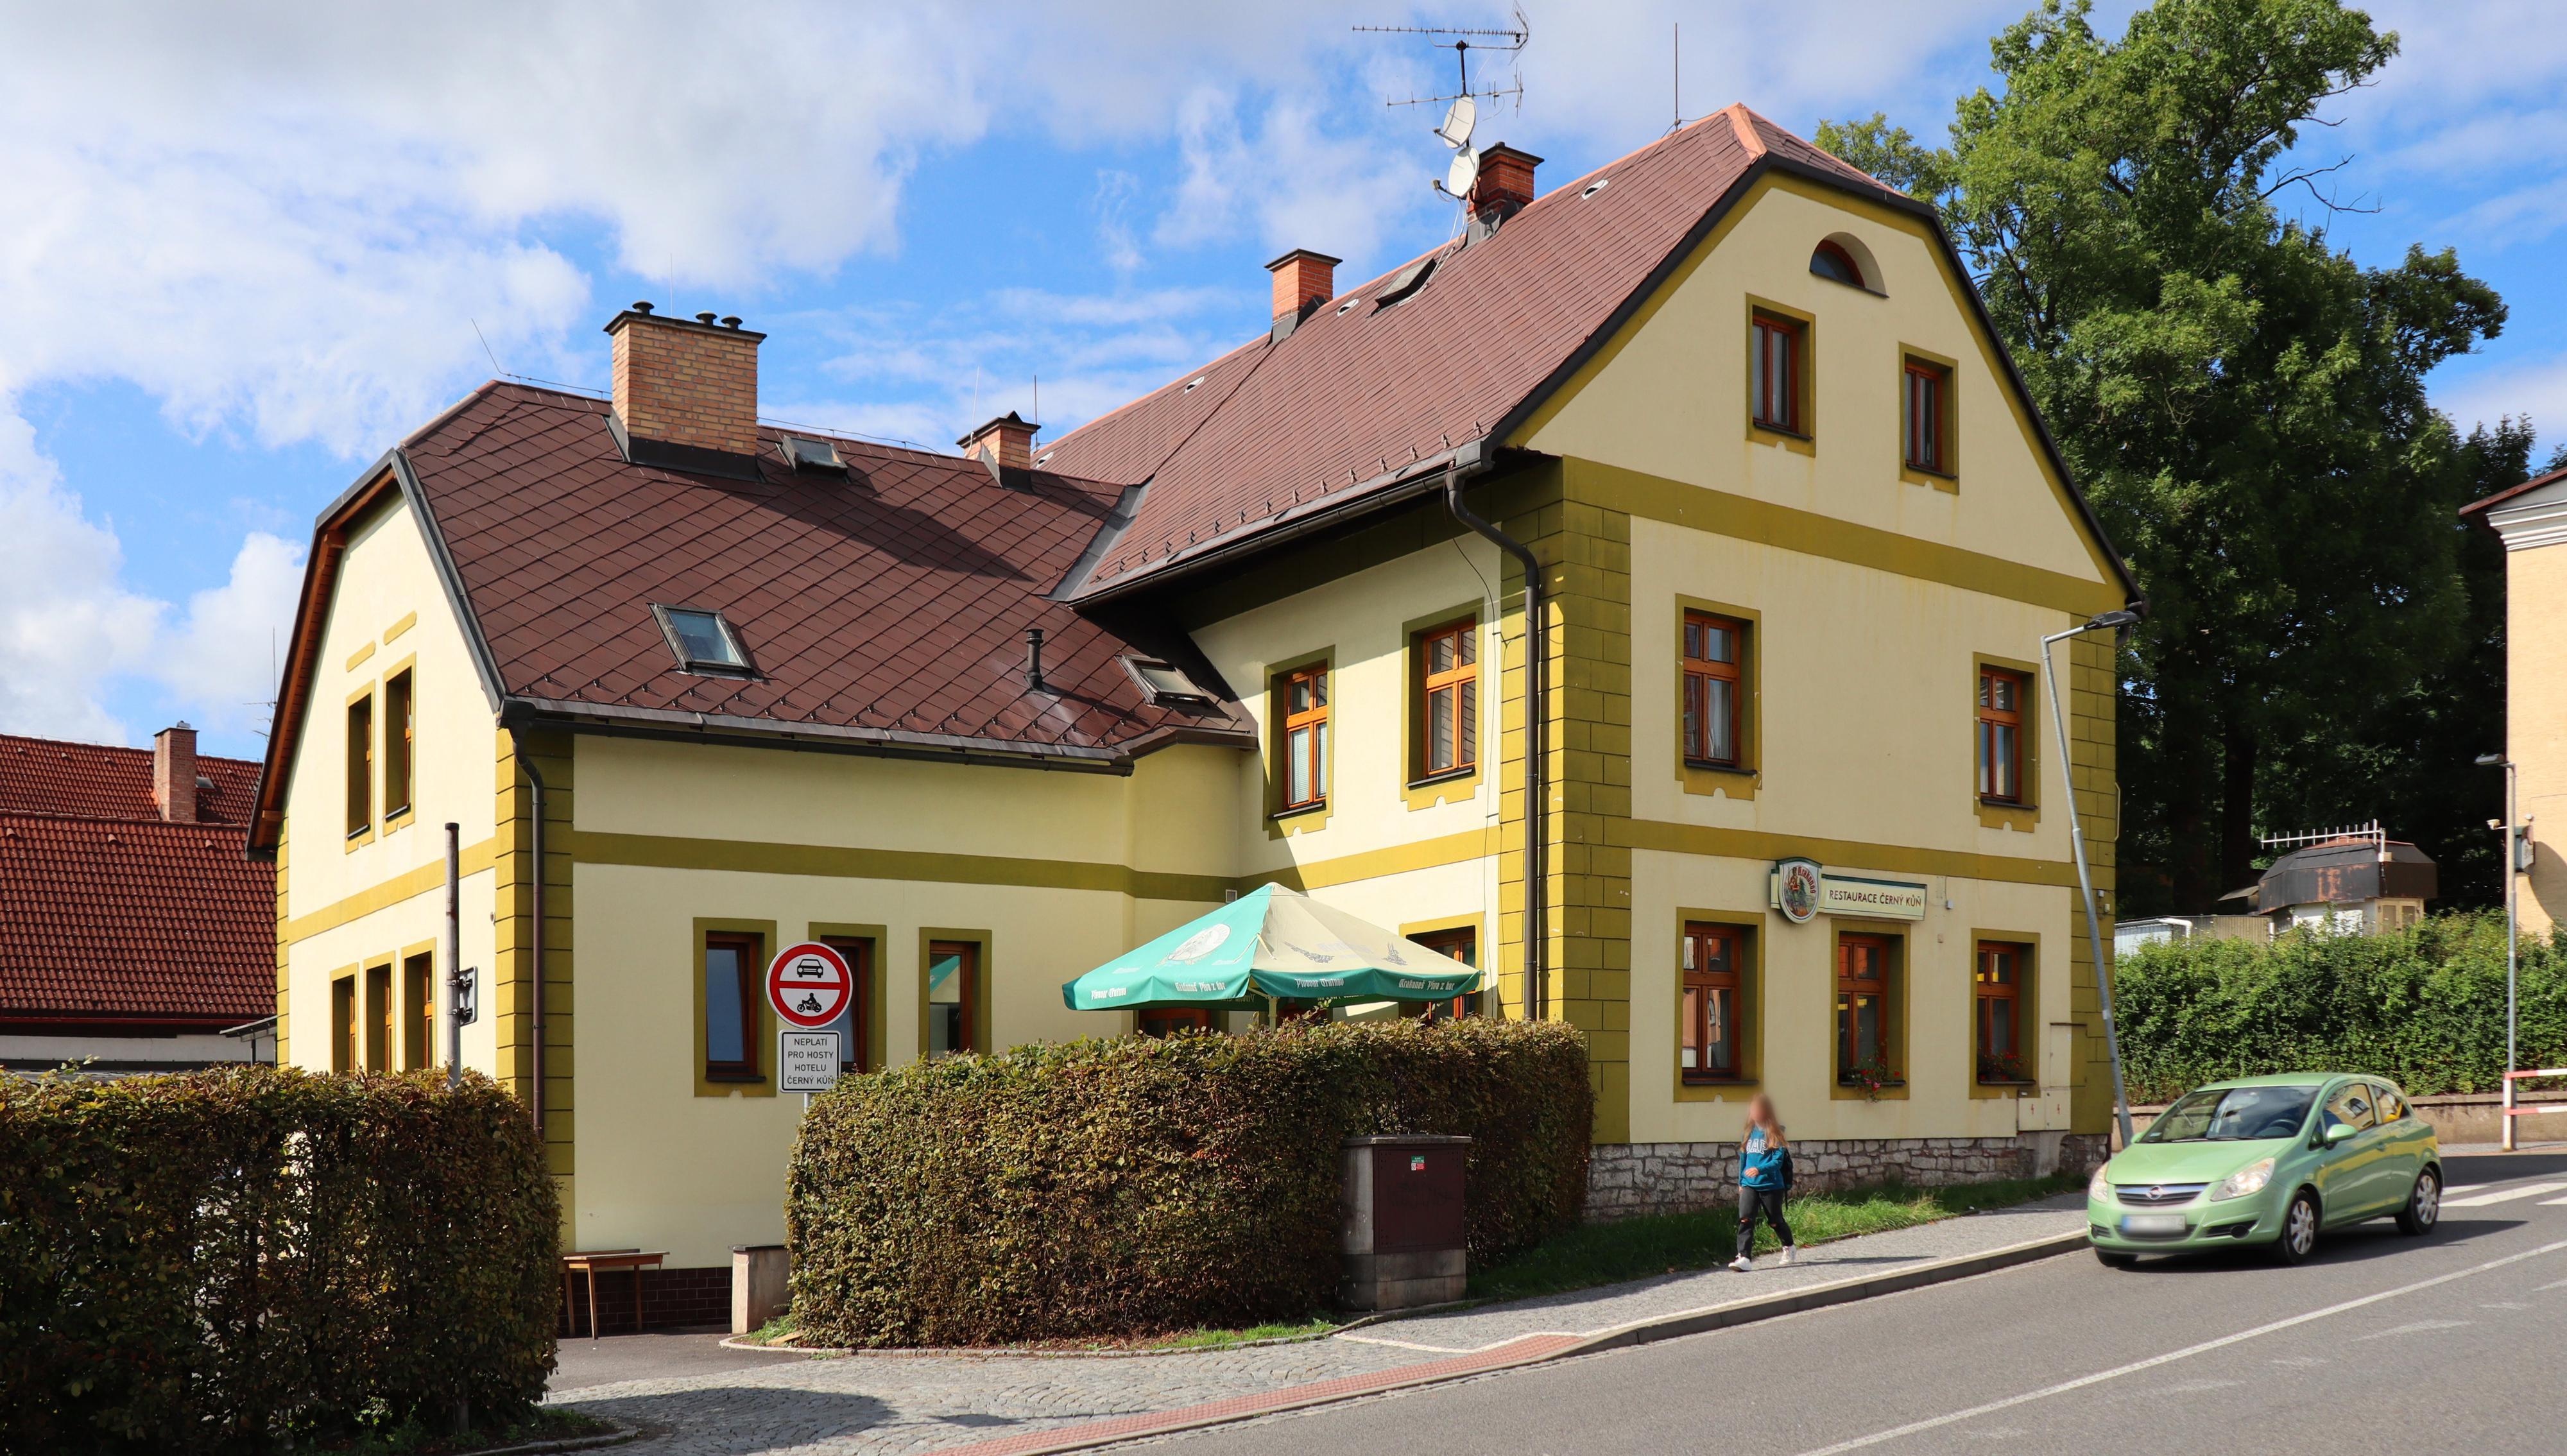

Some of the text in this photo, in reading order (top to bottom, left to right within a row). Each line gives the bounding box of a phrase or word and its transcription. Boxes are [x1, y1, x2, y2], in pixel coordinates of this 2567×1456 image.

[1830, 889, 1921, 907] RESTAURACE ČERNÝ KŮŇ
[794, 1037, 828, 1046] NEPLATÍ
[787, 1075, 814, 1084] ČERNÝ
